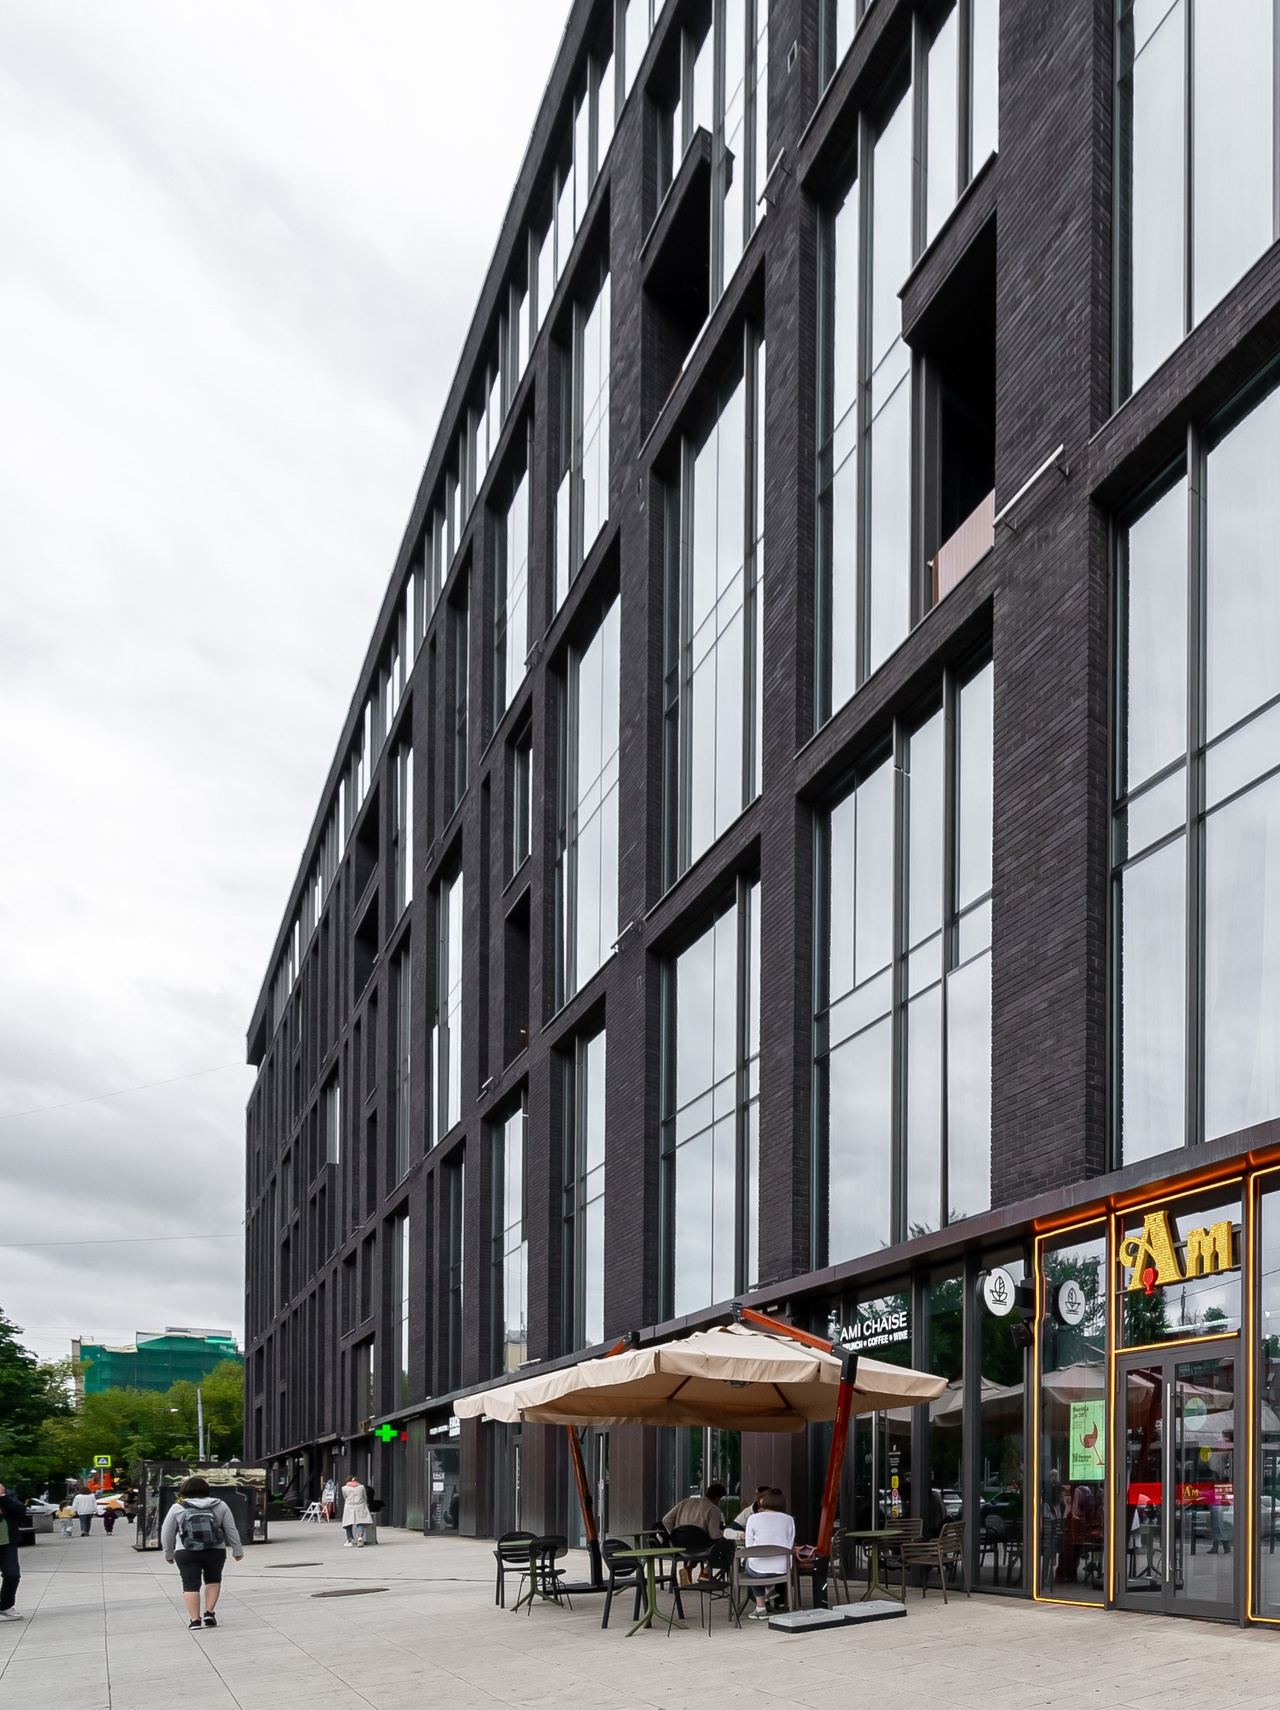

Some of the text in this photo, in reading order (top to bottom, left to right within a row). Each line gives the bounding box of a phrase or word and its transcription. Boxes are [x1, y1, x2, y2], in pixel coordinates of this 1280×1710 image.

[840, 1311, 908, 1342] AMI CHAISE
[868, 1334, 889, 1347] COFFEE
